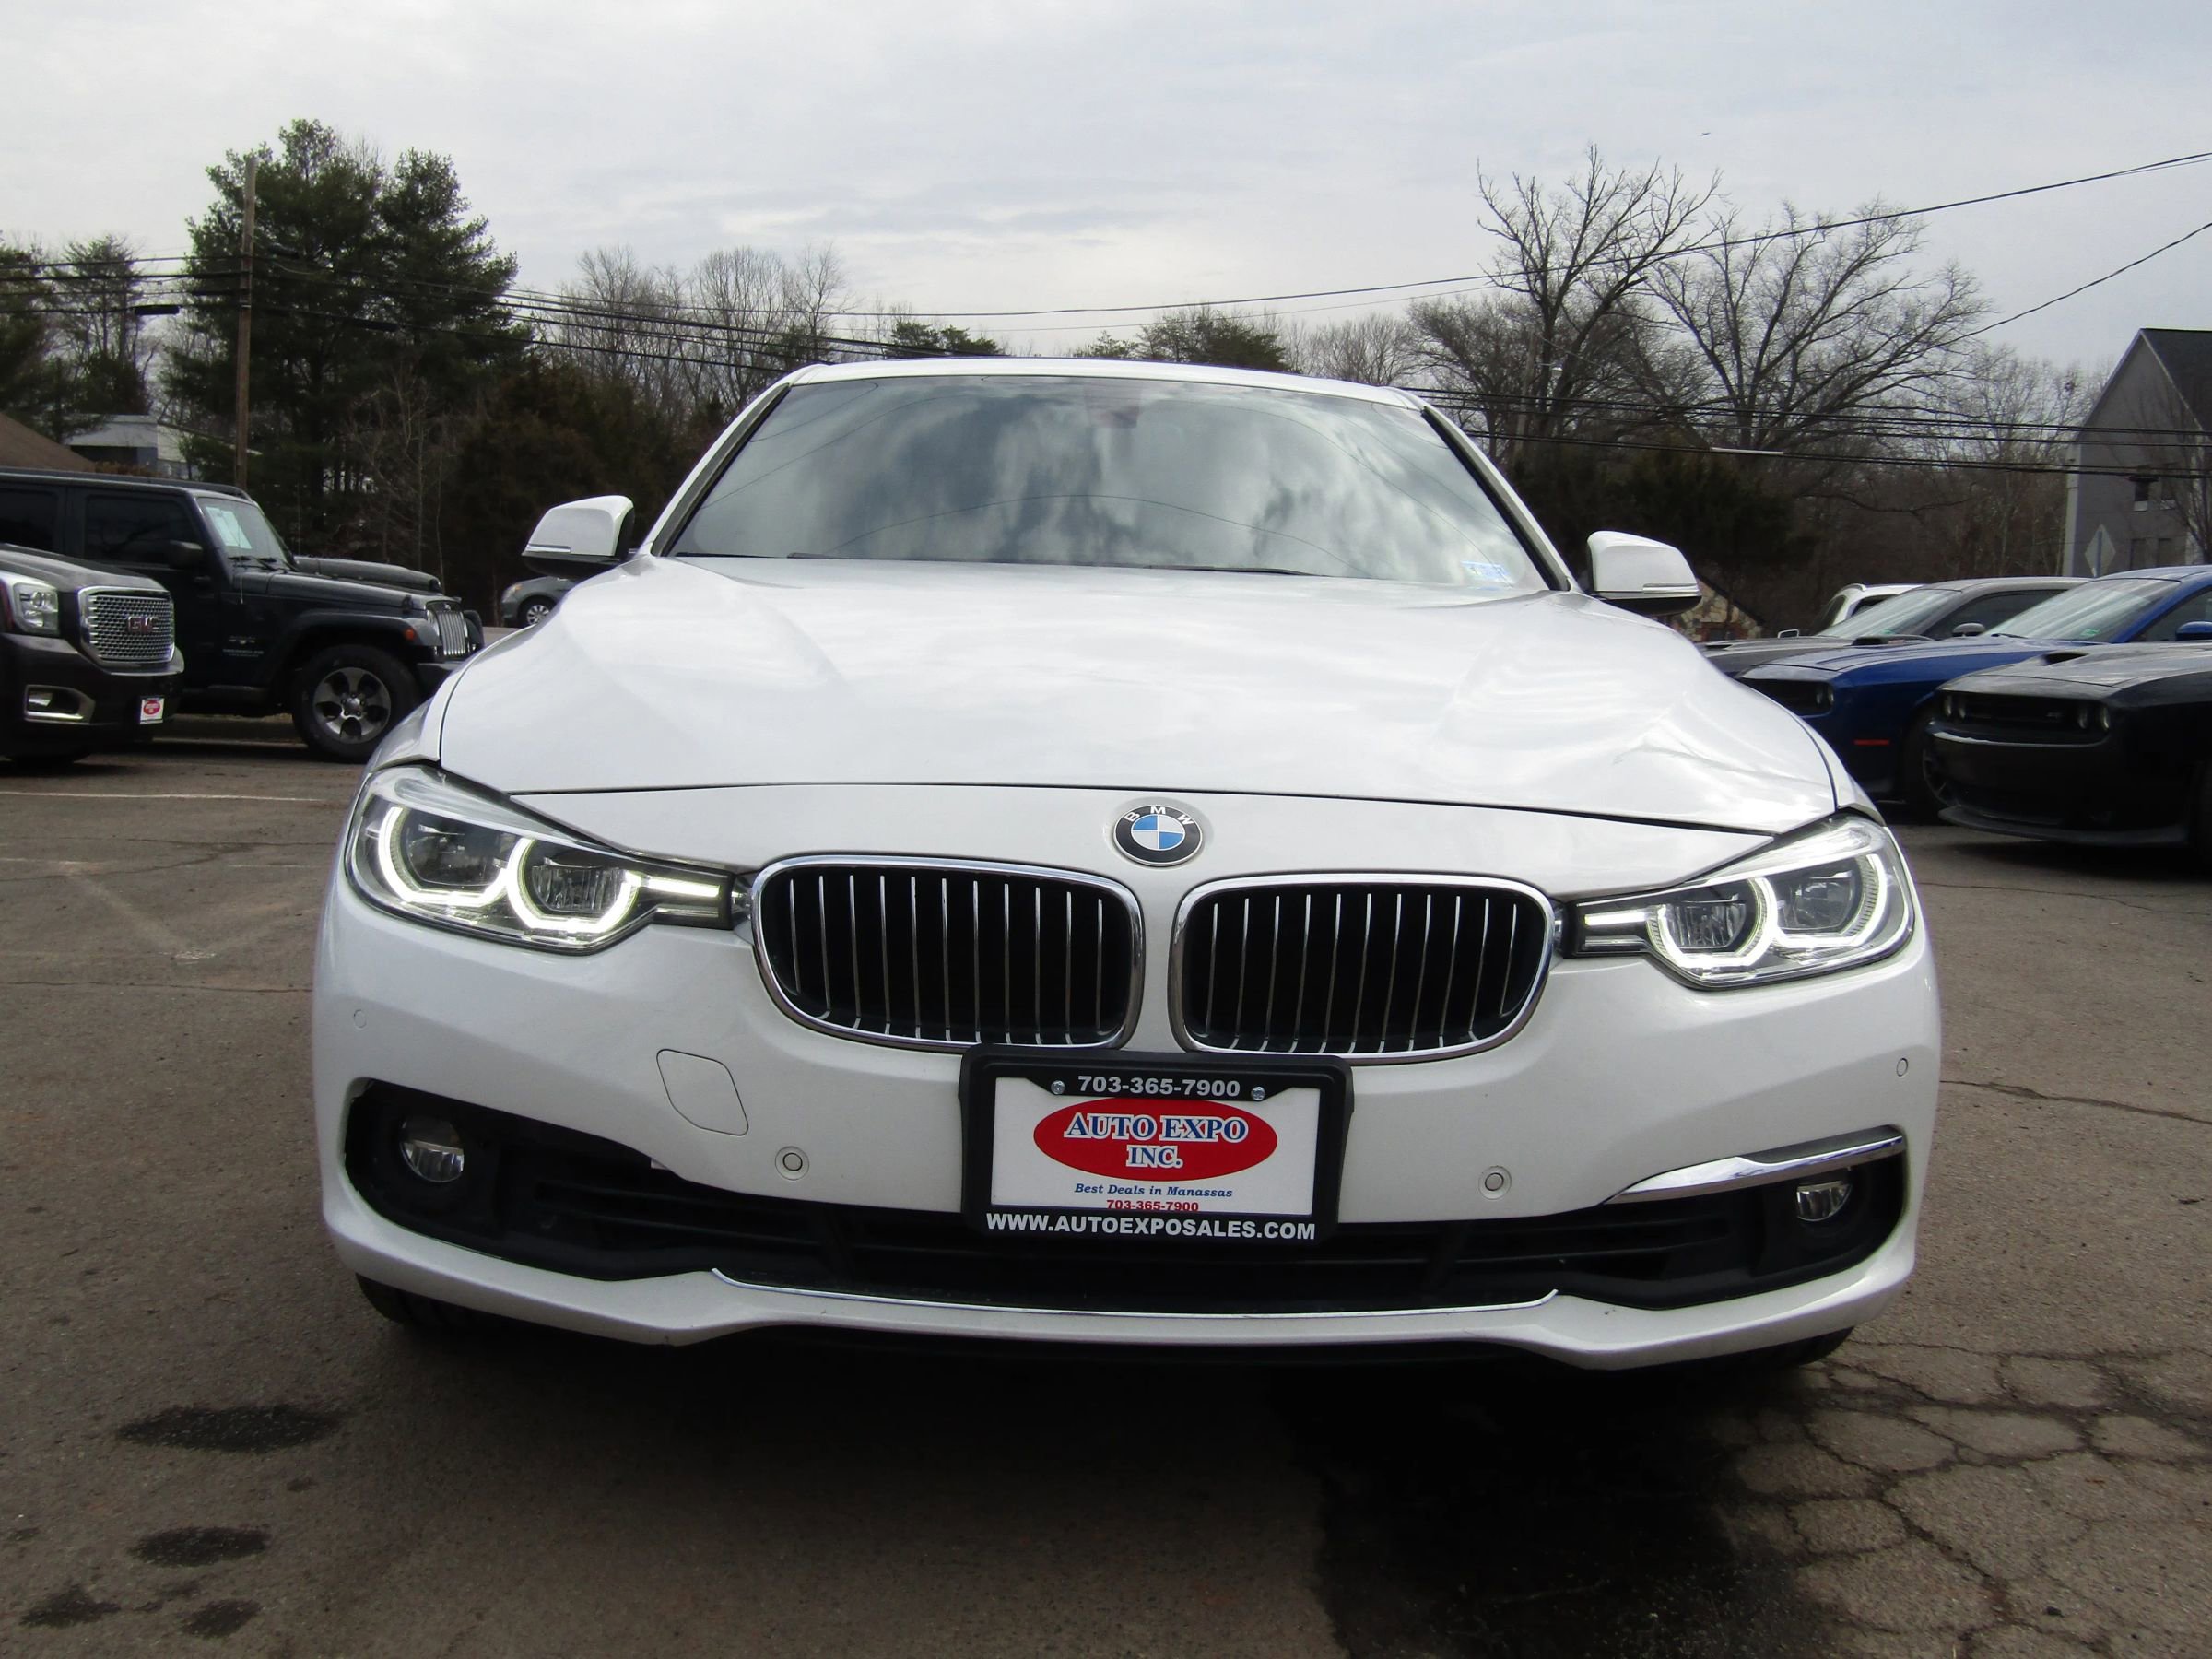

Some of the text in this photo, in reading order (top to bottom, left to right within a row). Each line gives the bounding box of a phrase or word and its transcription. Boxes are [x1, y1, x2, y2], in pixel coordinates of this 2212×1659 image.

[1123, 806, 1194, 826] BMW
[1077, 1075, 1241, 1097] 703-365-7900
[1065, 1113, 1248, 1143] AUTO EXPO
[1126, 1145, 1183, 1169] INC.
[1074, 1183, 1233, 1198] Best Deals in Manassas
[1106, 1199, 1199, 1212] 703-365-7900
[985, 1213, 1316, 1241] WWW.AUTOEXPOSALES.COM
